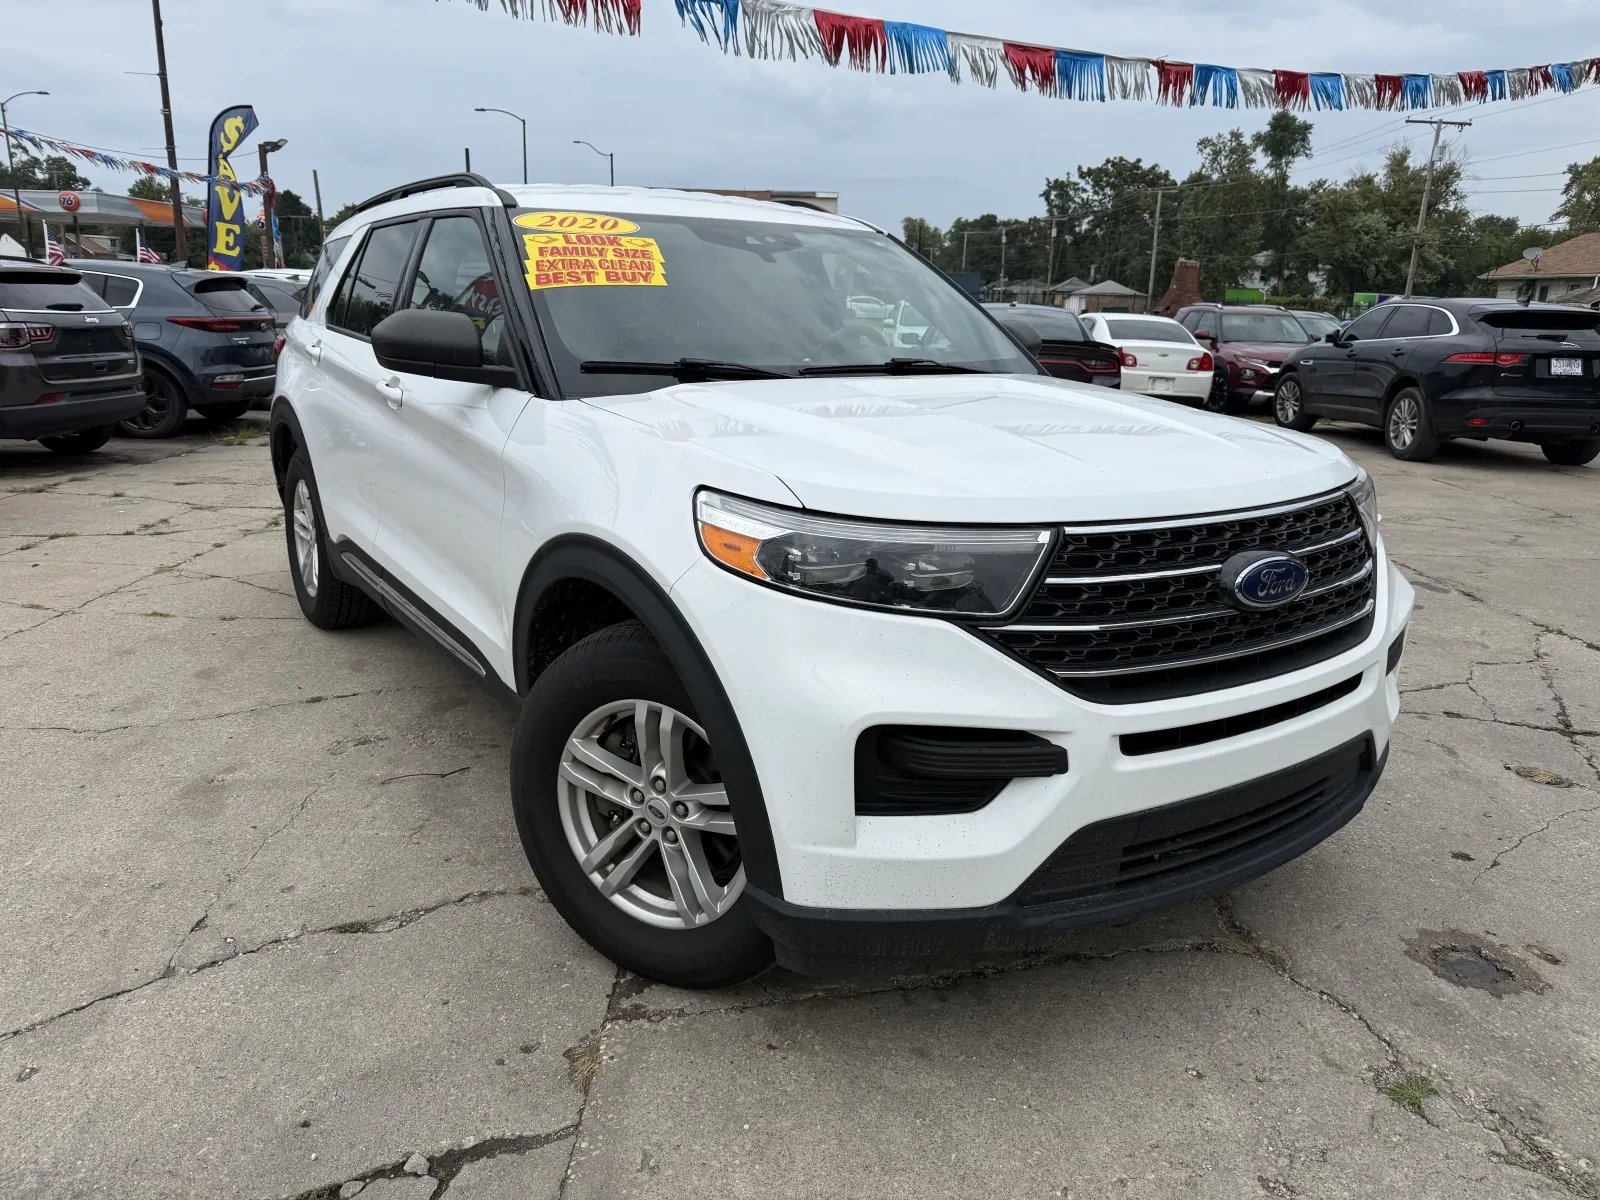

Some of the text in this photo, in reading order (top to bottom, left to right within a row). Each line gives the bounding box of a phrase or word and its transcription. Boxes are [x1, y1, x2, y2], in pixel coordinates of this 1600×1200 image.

[61, 196, 75, 206] 76
[537, 215, 619, 231] 2020
[562, 234, 625, 247] LOOK
[537, 245, 655, 260] FAMILY SIZE
[535, 258, 655, 272] EXTRA CLEAN
[535, 271, 653, 286] BEST BUY
[1257, 566, 1296, 597] Ford
